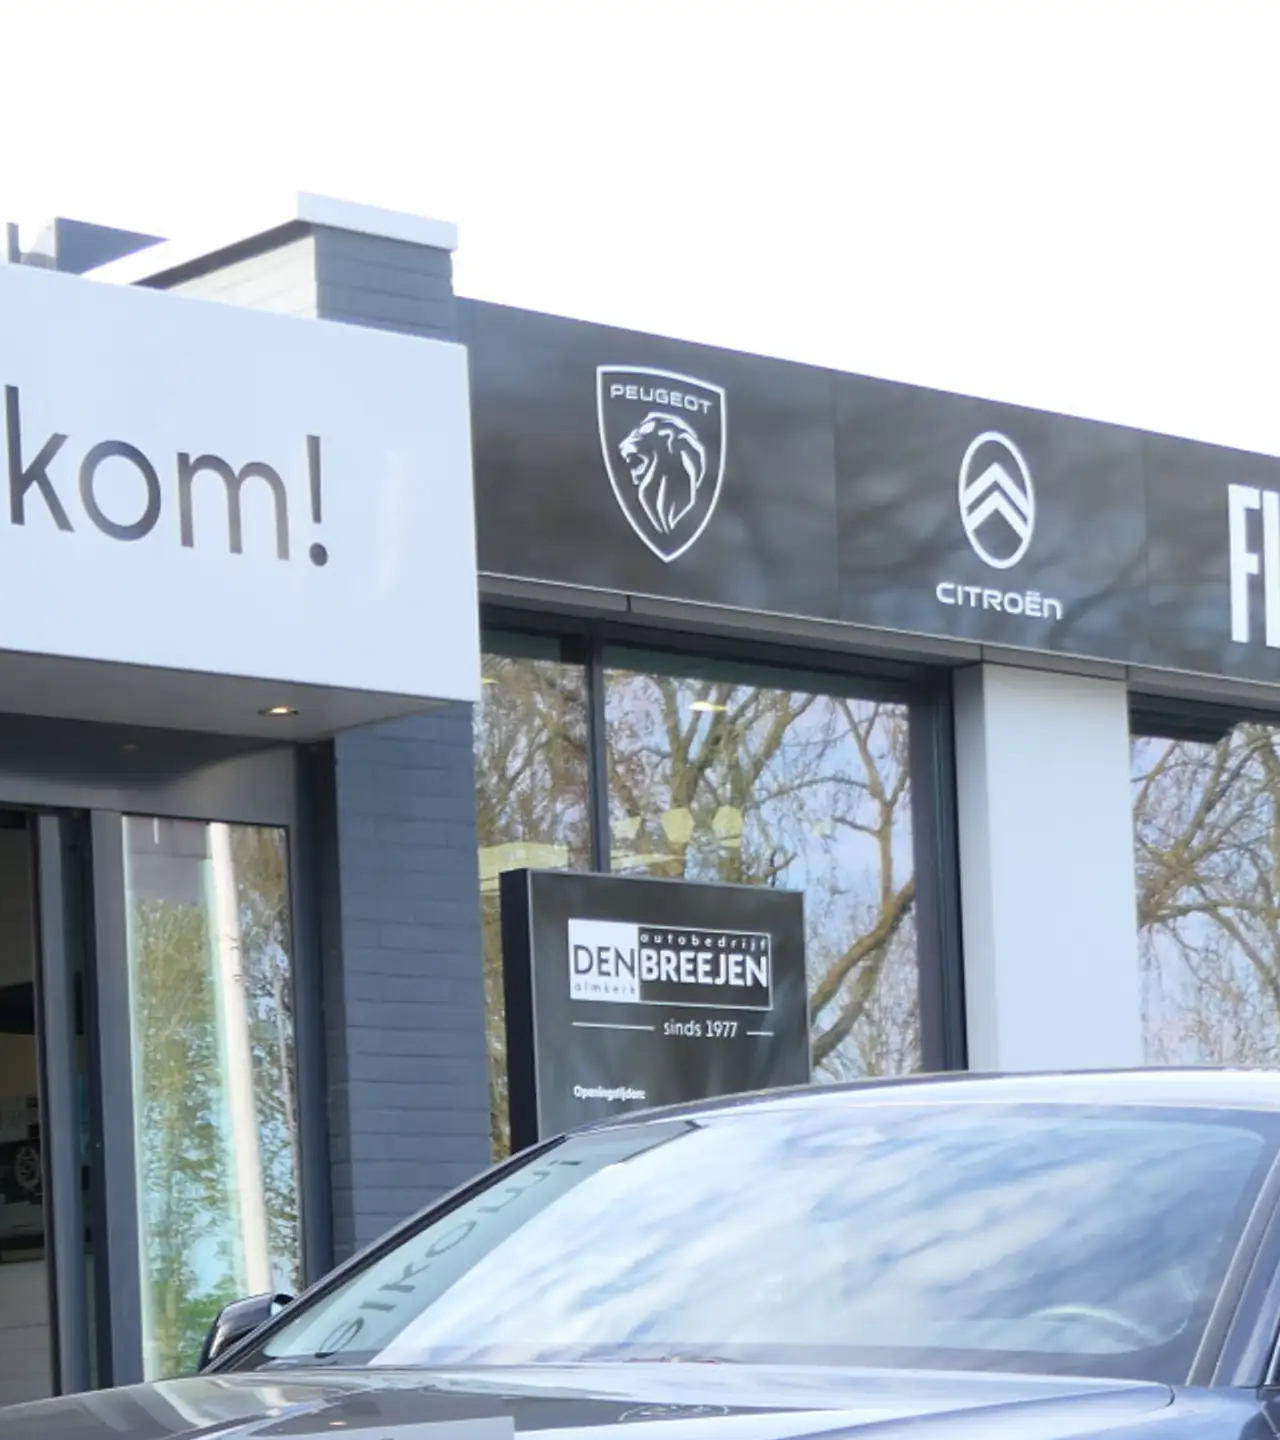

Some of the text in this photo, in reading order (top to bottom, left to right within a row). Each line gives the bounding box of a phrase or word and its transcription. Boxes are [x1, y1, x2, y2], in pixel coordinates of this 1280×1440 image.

[609, 383, 713, 415] PEUGEOT
[640, 932, 767, 952] autobedrijf
[573, 944, 768, 988] DEN BREEJEN
[664, 1020, 738, 1039] sinds 1977
